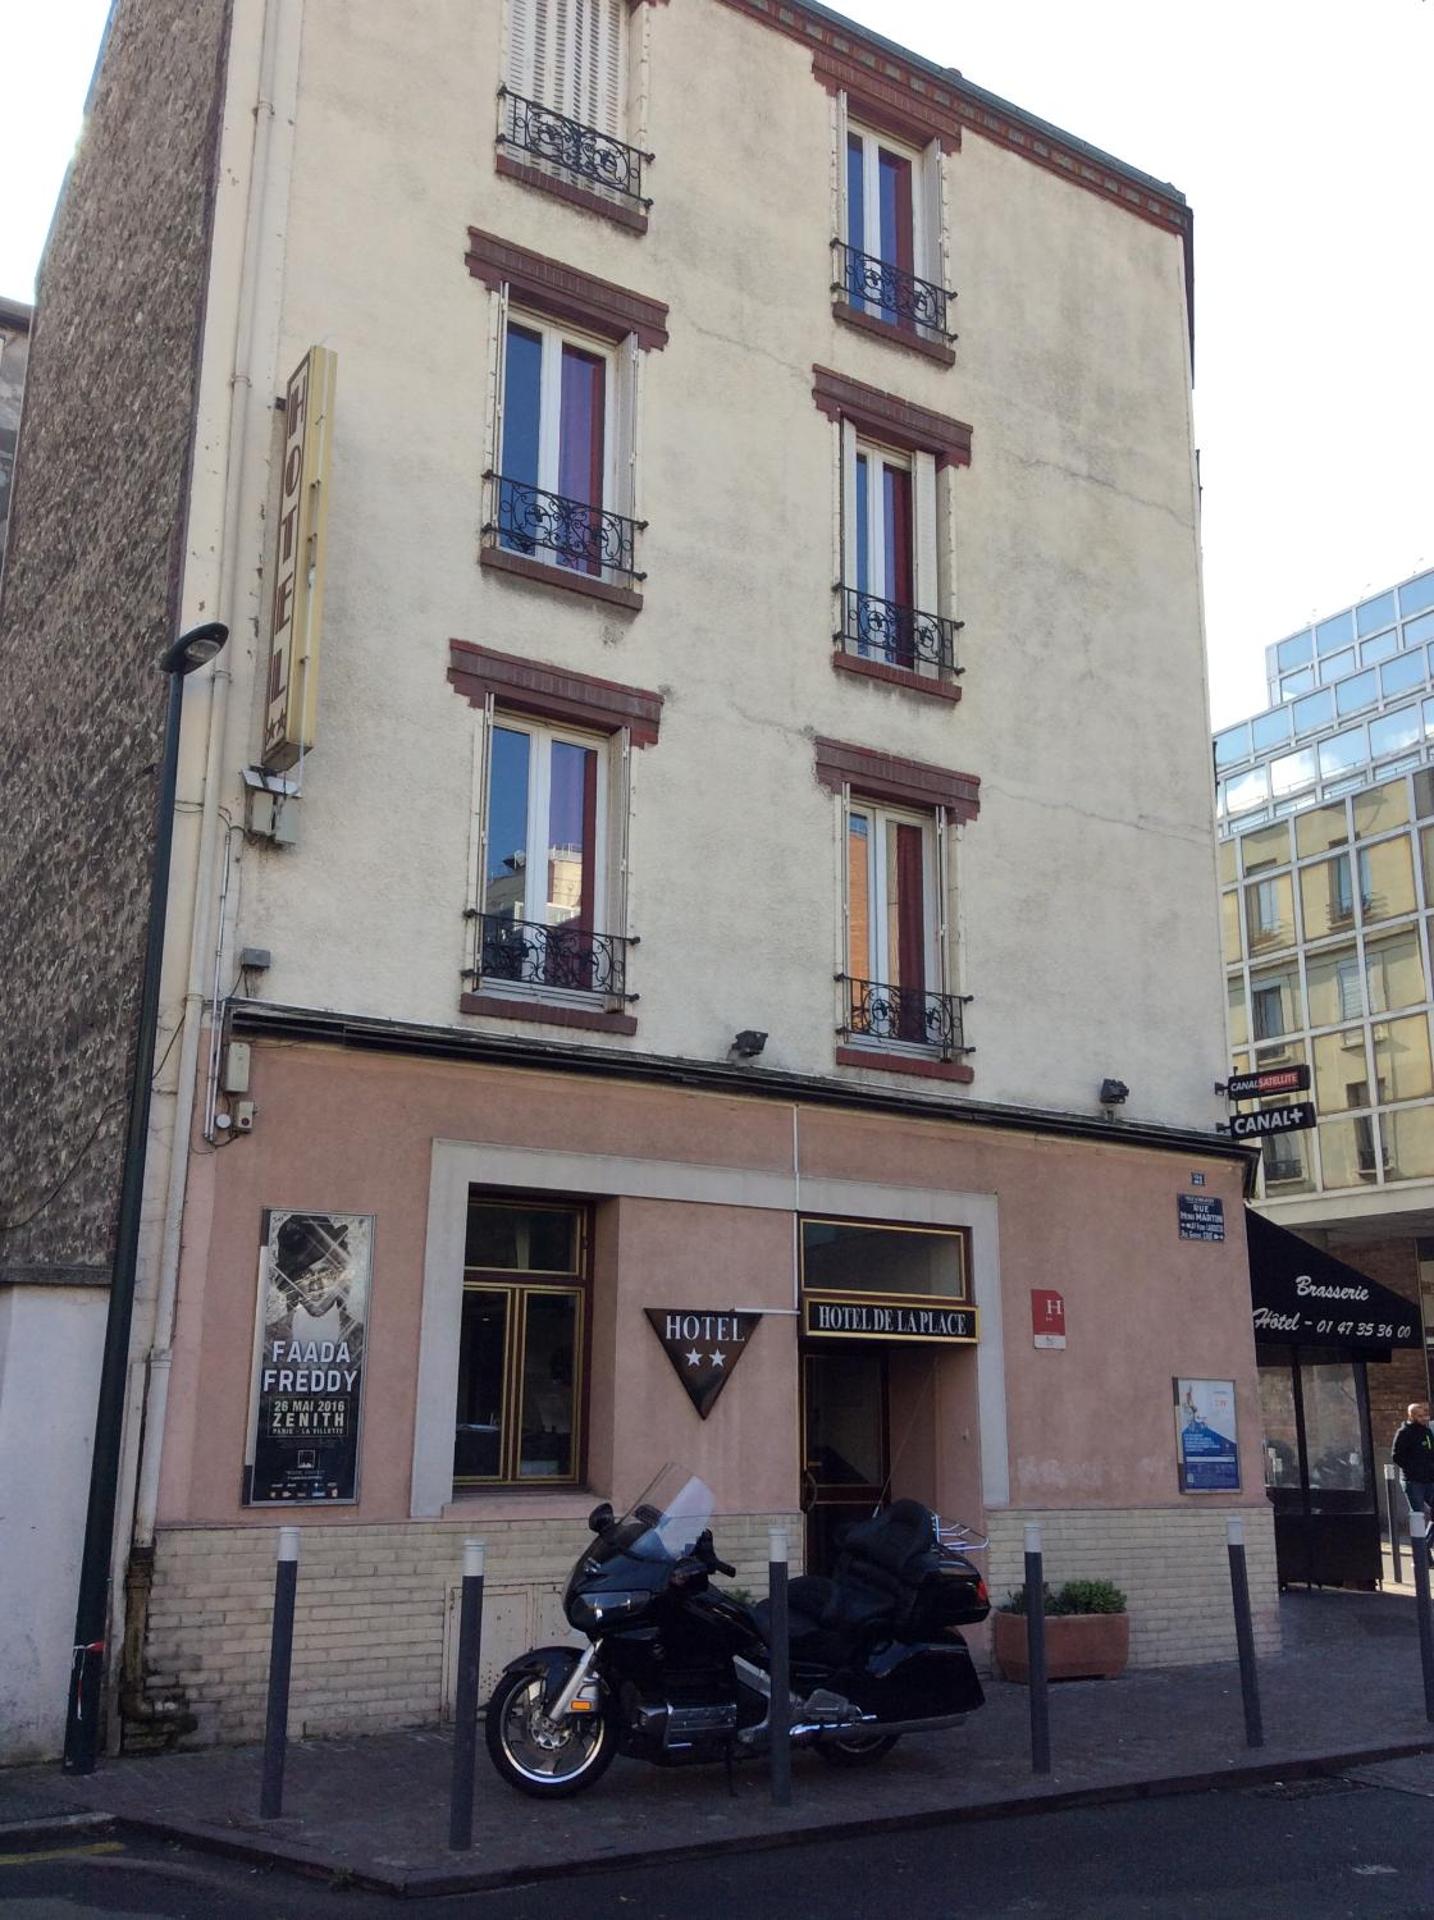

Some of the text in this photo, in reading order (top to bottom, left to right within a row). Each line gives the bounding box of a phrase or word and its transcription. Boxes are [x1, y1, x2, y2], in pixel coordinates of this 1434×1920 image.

[270, 375, 306, 704] HOTEL
[1234, 1108, 1303, 1134] CANAL+
[1193, 1204, 1209, 1213] RUE
[1295, 1275, 1370, 1301] Brasserie
[1047, 1299, 1062, 1315] H
[665, 1315, 745, 1341] HOTEL
[818, 1305, 967, 1336] HOTEL DE LA PLACE
[1252, 1307, 1301, 1332] Hôtel
[1316, 1320, 1333, 1334] 01
[1337, 1322, 1354, 1335] 47
[1356, 1323, 1374, 1337] 35
[1377, 1324, 1393, 1338] 36
[1397, 1325, 1411, 1339] 00
[272, 1340, 351, 1363] FAADA
[263, 1369, 358, 1392] FREDDY
[292, 1401, 314, 1412] MAI
[317, 1401, 345, 1412] 2016
[272, 1412, 344, 1427] ZENITH
